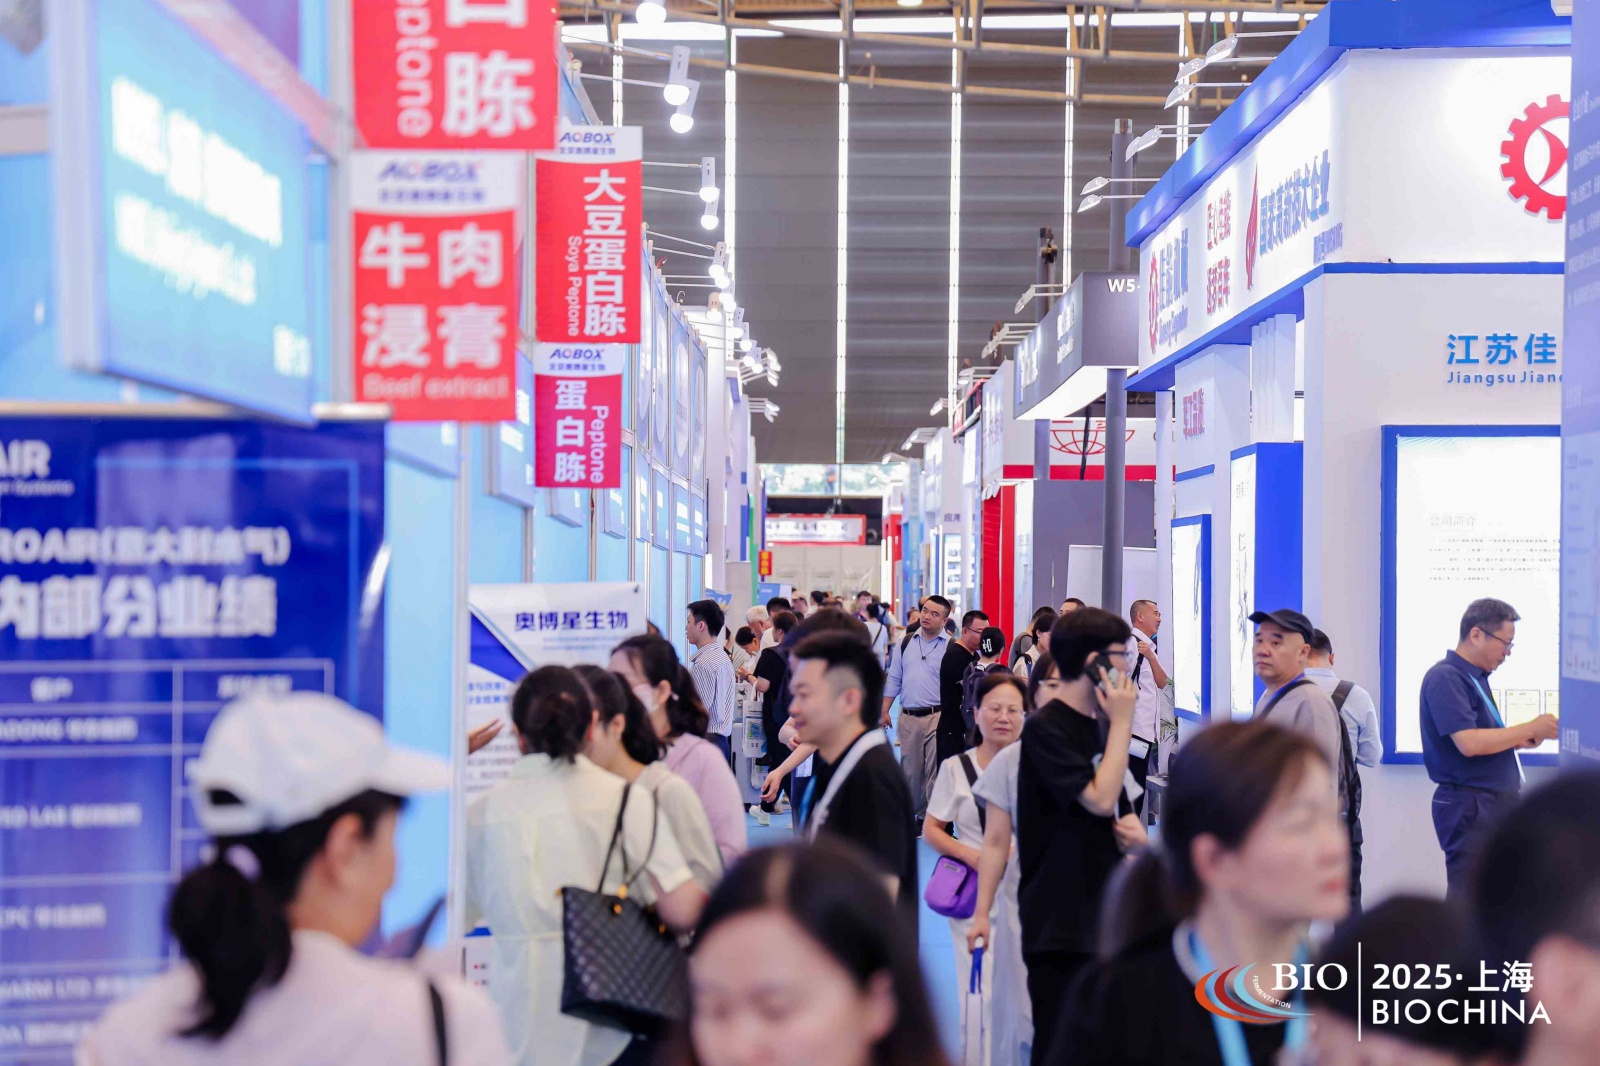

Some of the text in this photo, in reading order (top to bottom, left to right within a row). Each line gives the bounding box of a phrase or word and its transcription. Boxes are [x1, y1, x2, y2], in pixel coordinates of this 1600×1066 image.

[359, 221, 503, 289] 牛肉
[565, 235, 582, 337] Soya Peptone
[582, 168, 627, 337] 大豆蛋白胨
[361, 302, 506, 369] 浸膏
[549, 348, 604, 360] AOBOX
[1447, 332, 1557, 365] 江苏佳
[362, 372, 423, 400] Beef
[1447, 371, 1516, 387] Jiangsu
[554, 380, 587, 483] 蛋白胨
[587, 405, 609, 483] Peptone
[515, 611, 628, 631] 奥博星生物
